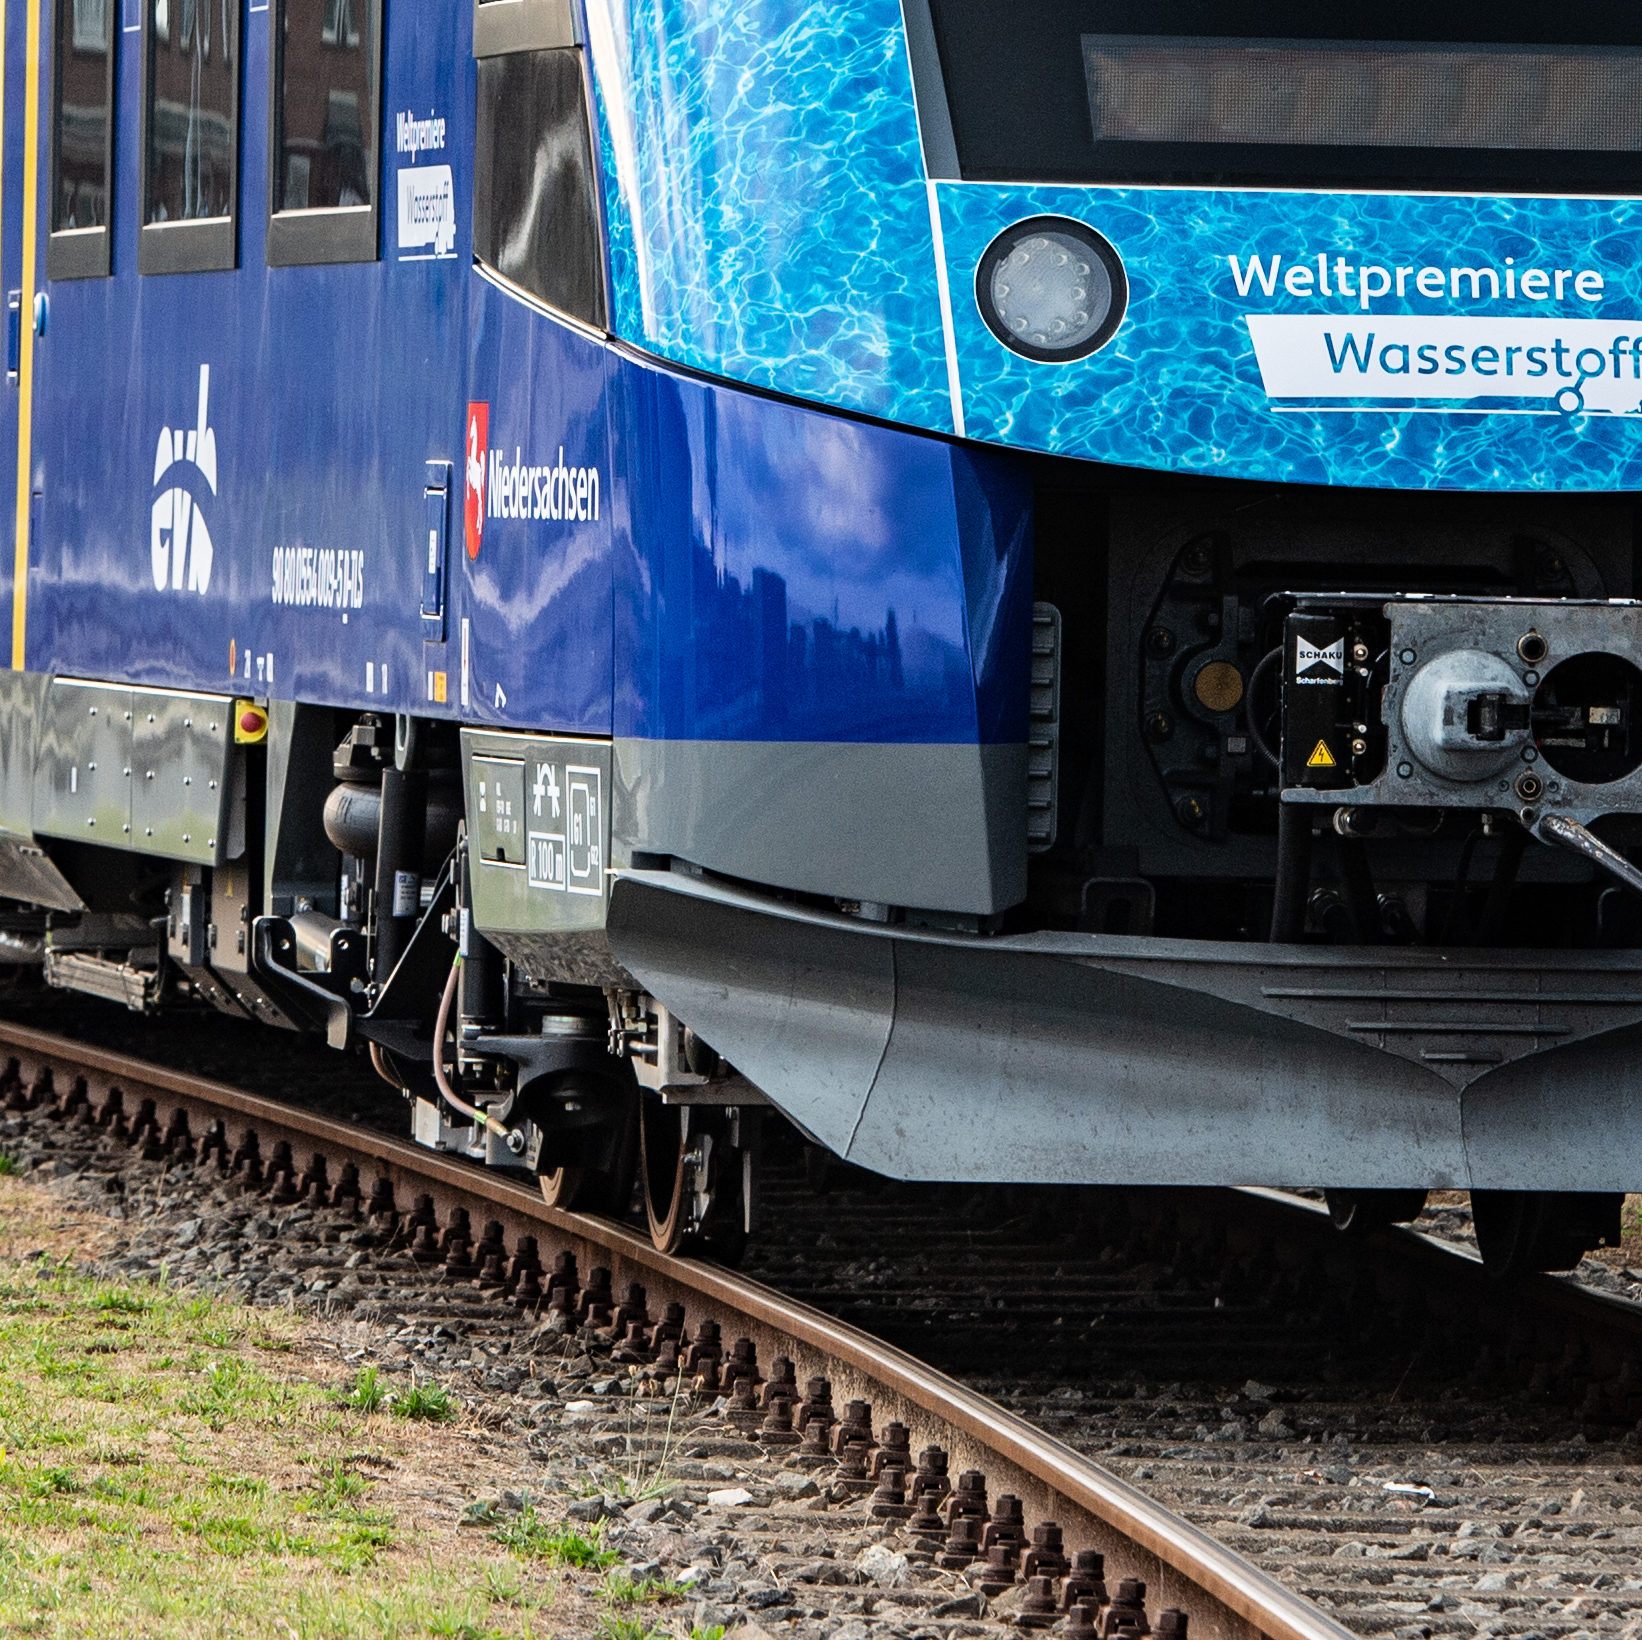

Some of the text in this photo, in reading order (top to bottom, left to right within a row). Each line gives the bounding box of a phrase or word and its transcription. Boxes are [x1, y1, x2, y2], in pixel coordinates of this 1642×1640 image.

[396, 108, 446, 163] Weltpremiere
[406, 180, 449, 224] Wasserstoff
[1227, 252, 1606, 305] Weltpremiere
[487, 445, 599, 522] Niedersachsen
[272, 546, 283, 604] 90
[283, 547, 295, 605] 80
[1299, 650, 1343, 660] SCHAKU
[1295, 676, 1344, 686] Scharfenberg
[531, 839, 563, 881] R 100 m
